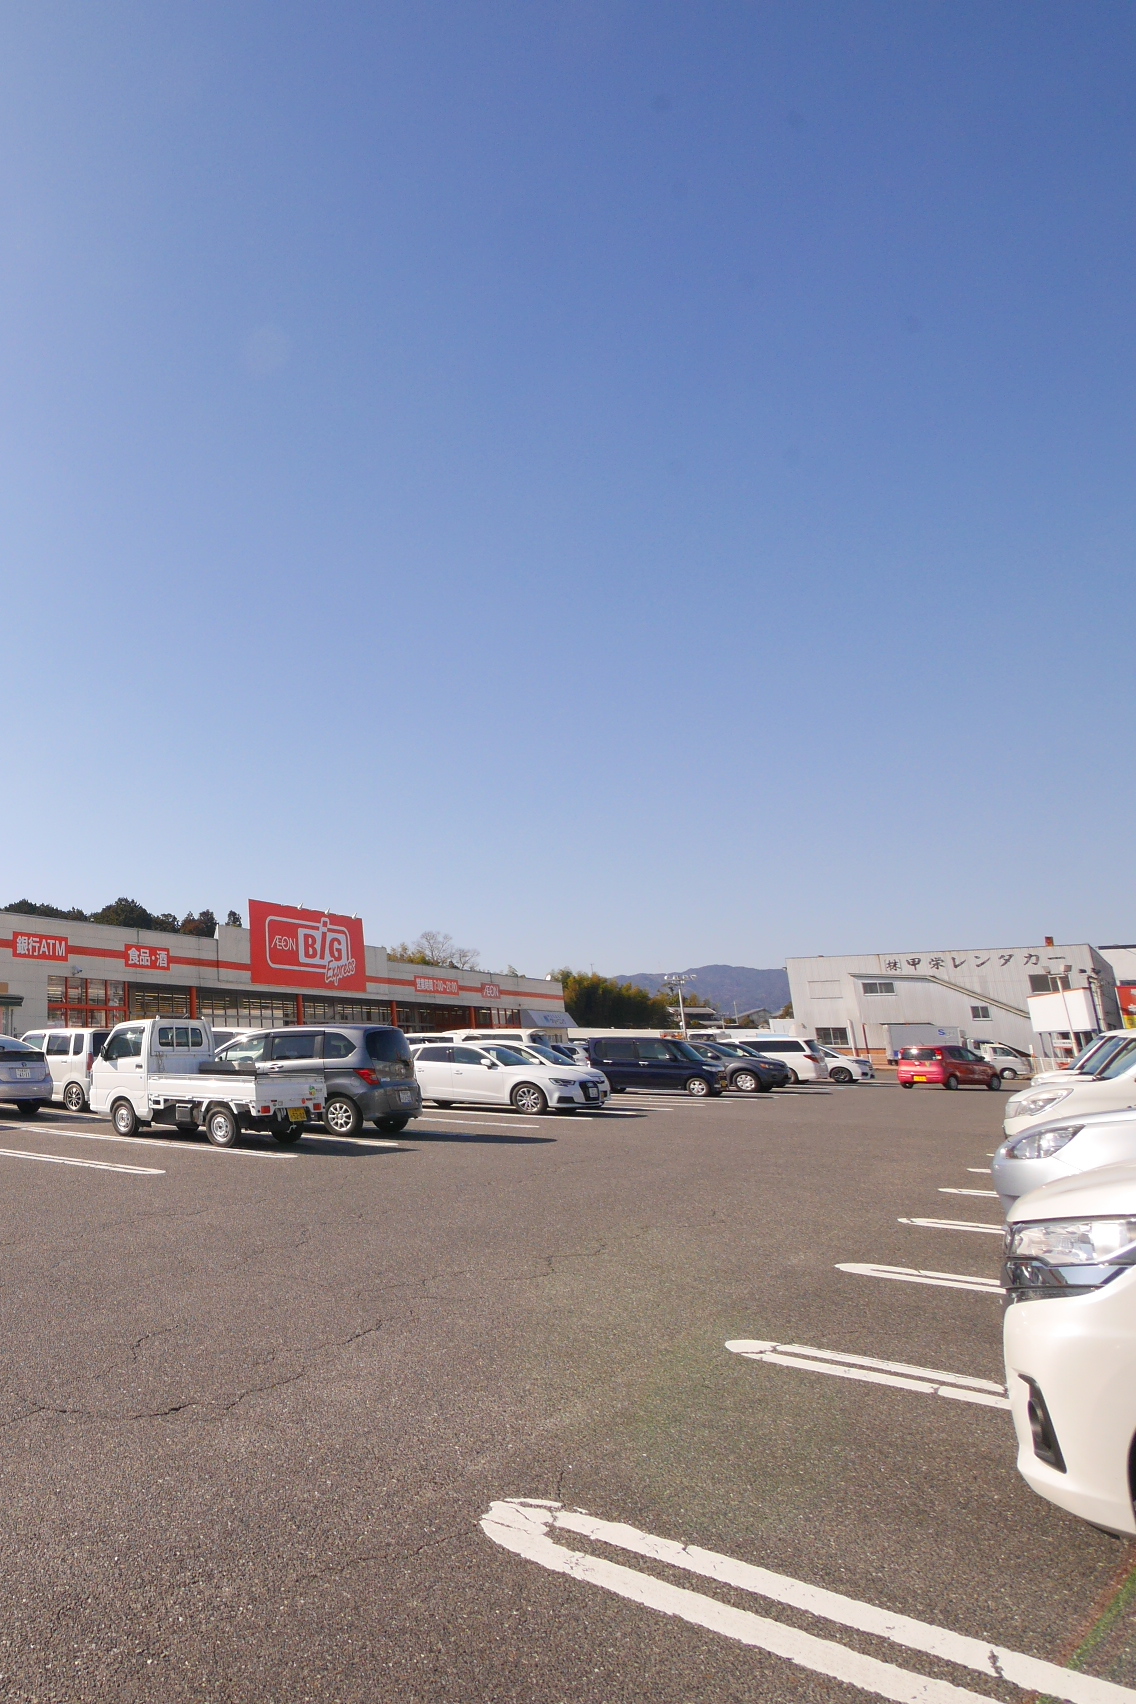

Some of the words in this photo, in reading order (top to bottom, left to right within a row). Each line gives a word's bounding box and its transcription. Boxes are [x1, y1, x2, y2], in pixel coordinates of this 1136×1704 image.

[16, 935, 66, 957] 銀行ATM
[128, 947, 168, 967] 食品・酒
[325, 958, 356, 986] Express
